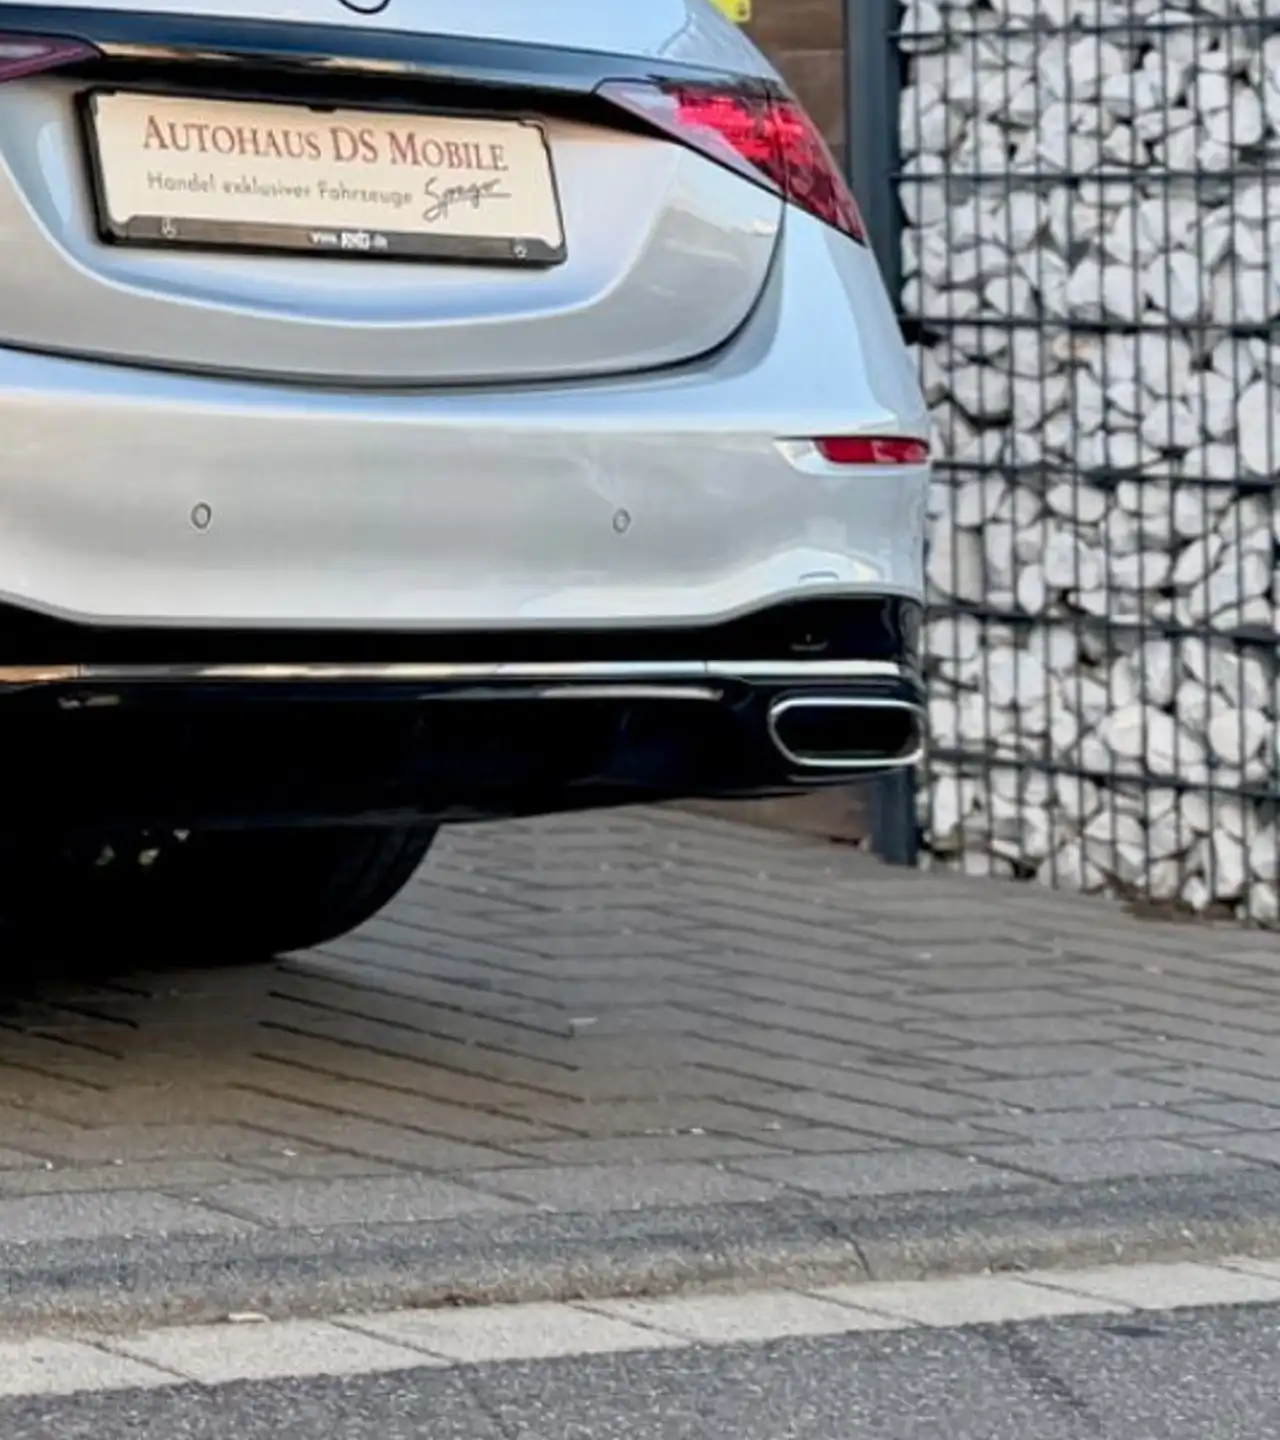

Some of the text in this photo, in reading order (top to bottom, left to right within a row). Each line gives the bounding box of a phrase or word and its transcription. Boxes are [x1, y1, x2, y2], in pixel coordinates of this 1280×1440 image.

[143, 115, 510, 172] AUTOHAUS DS MOBILE
[147, 169, 216, 193] Handel
[317, 179, 414, 209] Fahrzeuge
